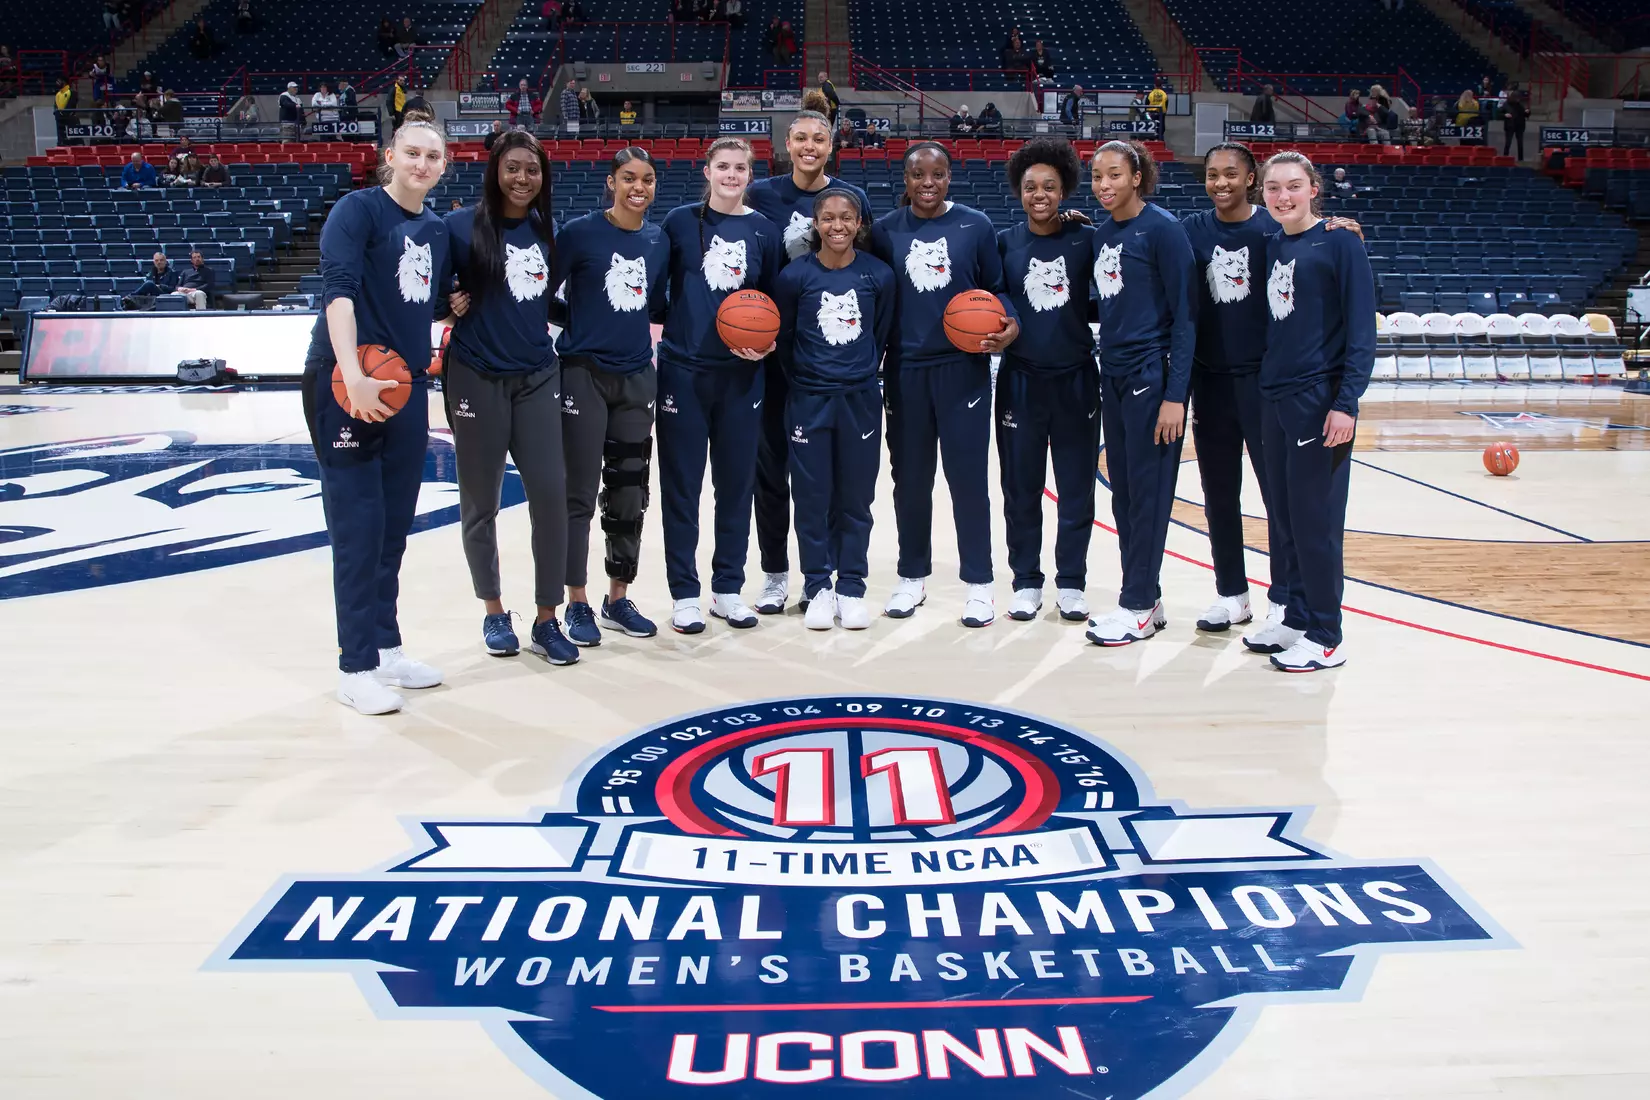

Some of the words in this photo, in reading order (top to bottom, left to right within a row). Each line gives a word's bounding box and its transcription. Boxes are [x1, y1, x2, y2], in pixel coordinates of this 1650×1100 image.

[645, 63, 665, 72] 221
[313, 124, 329, 132] SEC
[332, 122, 358, 133] 120
[744, 121, 766, 132] 121
[865, 119, 890, 130] 122
[1131, 121, 1156, 132] 122
[1250, 124, 1275, 136] 123
[69, 127, 84, 135] SEC
[87, 125, 114, 136] 120
[1440, 128, 1456, 136] SEC
[1460, 126, 1483, 138] 123
[1565, 131, 1589, 142] 124
[454, 409, 476, 418] UCONN
[332, 441, 360, 449] UCONN
[750, 746, 957, 826] 11
[692, 846, 892, 875] 11-TIME
[284, 894, 784, 941] NATIONAL
[836, 880, 1433, 940] CHAMPIONS
[454, 954, 790, 987] WOMEN'S
[839, 944, 1295, 984] BASKETBALL
[666, 1025, 1094, 1085] UCONN
